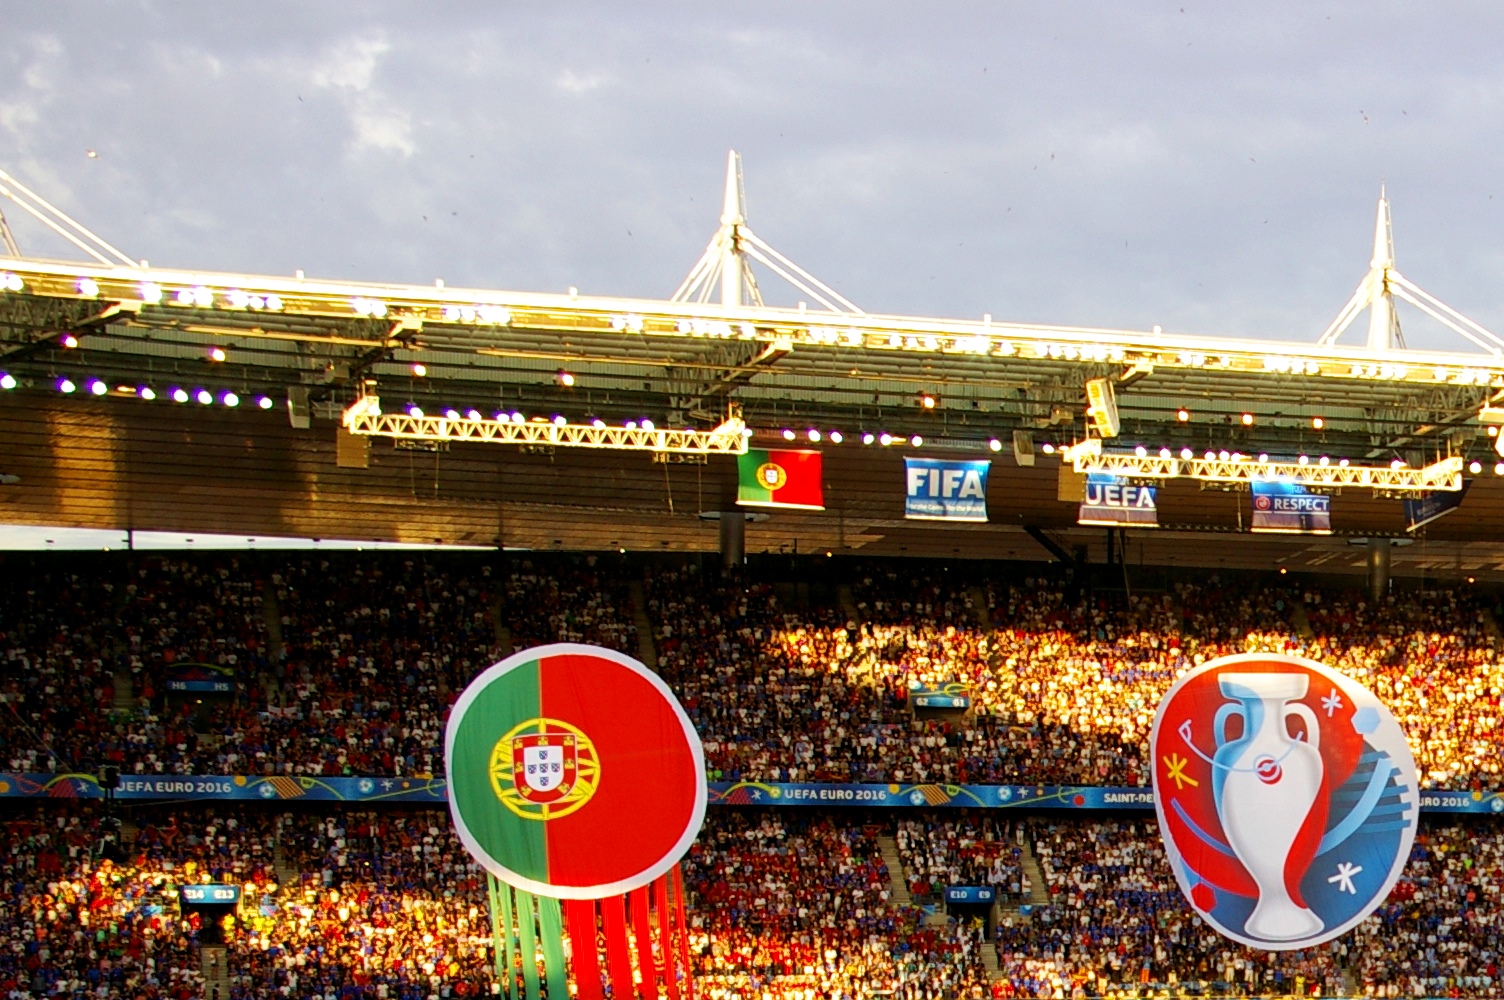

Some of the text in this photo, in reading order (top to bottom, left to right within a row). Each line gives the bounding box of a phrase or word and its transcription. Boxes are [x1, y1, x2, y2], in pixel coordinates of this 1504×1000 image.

[906, 467, 986, 499] FIFA
[1085, 484, 1156, 508] UEFA
[1274, 498, 1330, 511] RESPECT
[156, 782, 194, 793] EURO
[196, 782, 232, 793] 2016
[784, 789, 887, 801] UEFA EURO 2016
[1104, 793, 1153, 803] SAINT-DE
[1441, 798, 1468, 807] 2016
